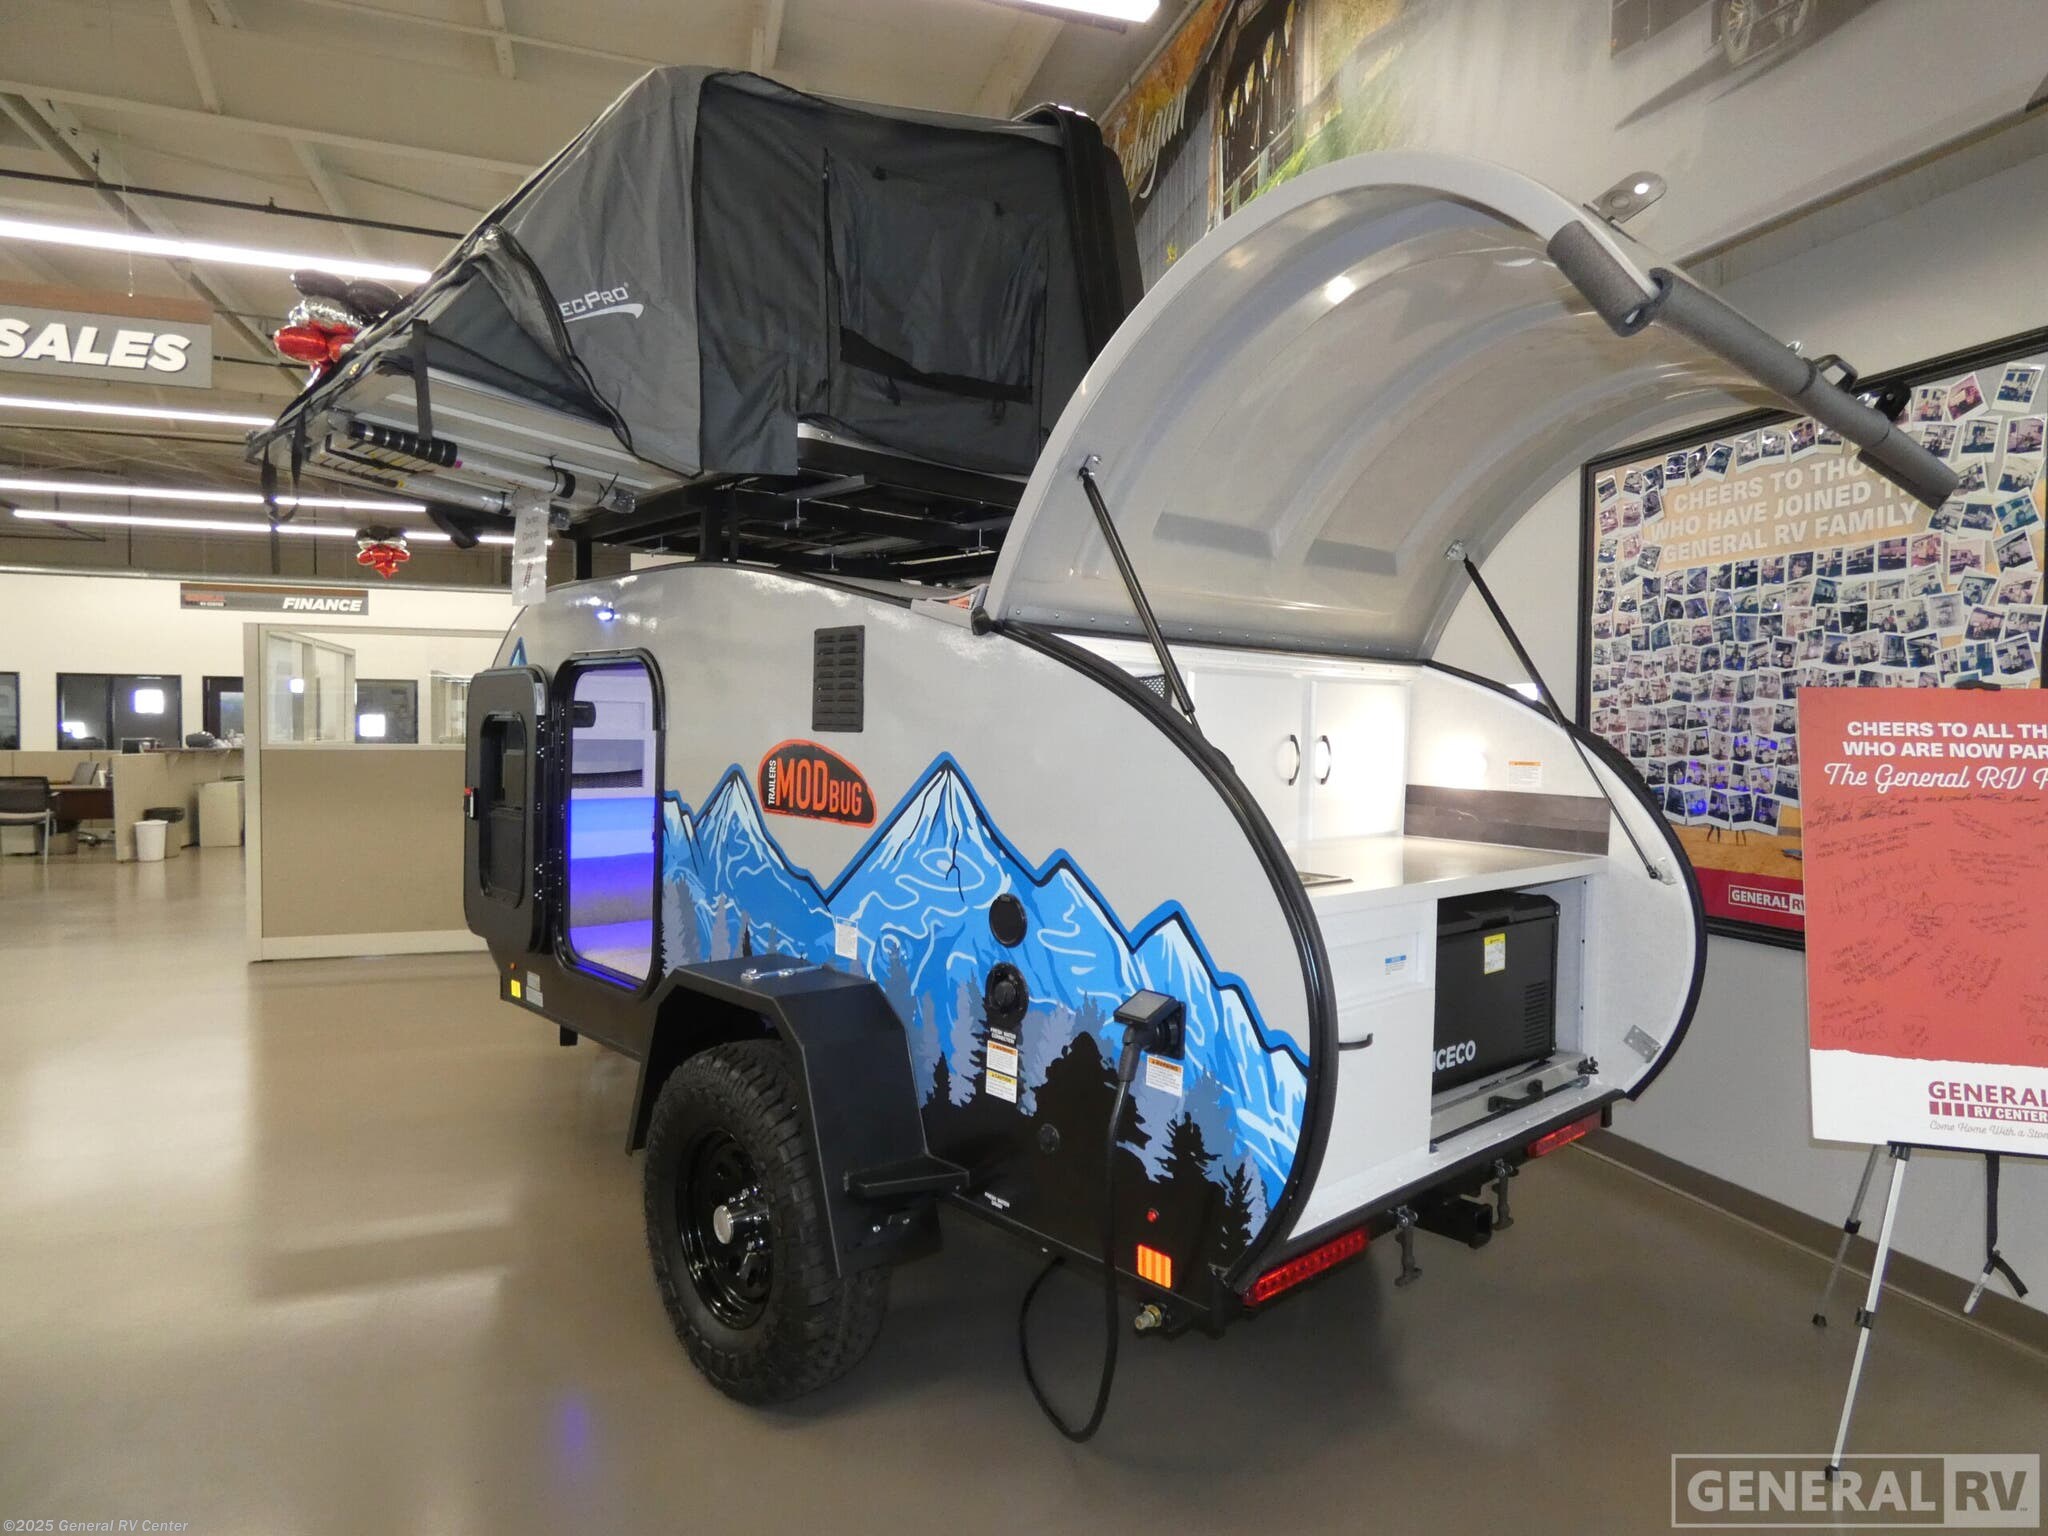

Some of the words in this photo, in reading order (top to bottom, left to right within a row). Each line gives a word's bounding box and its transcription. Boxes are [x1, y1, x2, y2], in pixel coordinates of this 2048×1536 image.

[0, 318, 192, 372] SALES
[1674, 477, 1764, 513] CHEERS
[1770, 466, 1804, 493] TO
[1809, 453, 1867, 486] THO
[1651, 515, 1700, 541] WHO
[1707, 501, 1768, 532] HAVE
[1774, 480, 1871, 519] JOINED
[1662, 528, 1768, 563] GENERAL
[1775, 519, 1808, 546] RV
[1815, 501, 1919, 538] FAMILY
[282, 597, 363, 612] FINANCE
[1847, 721, 1934, 738] CHEERS
[1938, 722, 1968, 738] TO
[1973, 723, 2014, 739] ALL
[1842, 741, 1896, 757] WHO
[1900, 742, 1944, 758] ARE
[1949, 743, 2004, 758] NOW
[767, 759, 777, 806] TRAILERS
[1823, 762, 1868, 786] The
[1874, 763, 1970, 794] General
[1975, 765, 2027, 790] RV
[1731, 889, 1789, 909] GENERAL
[1792, 898, 1804, 911] R
[1928, 1081, 2048, 1107] GENERAL
[1974, 1106, 1994, 1118] RV
[1929, 1120, 1955, 1132] Come
[1958, 1122, 1987, 1135] Home
[1989, 1124, 2016, 1137] With
[2017, 1129, 2025, 1138] a
